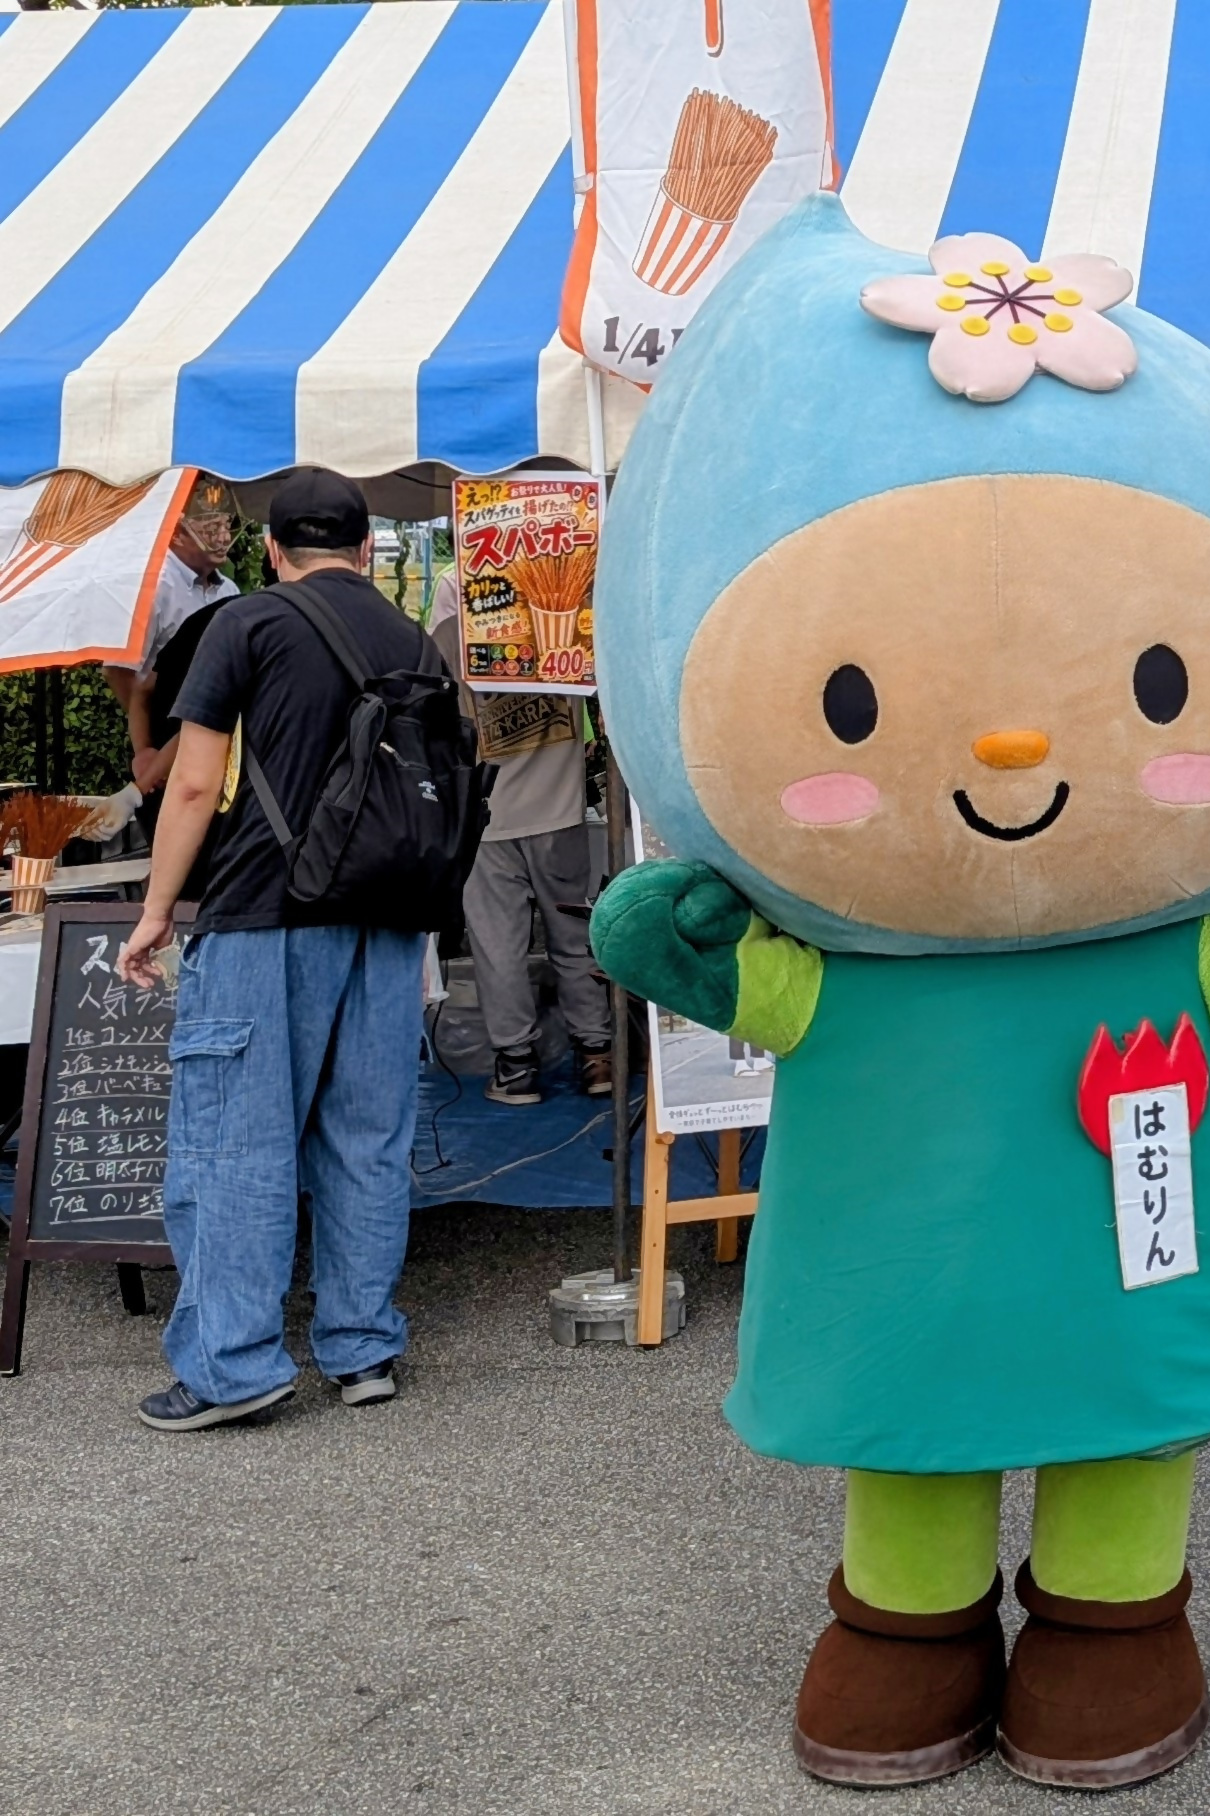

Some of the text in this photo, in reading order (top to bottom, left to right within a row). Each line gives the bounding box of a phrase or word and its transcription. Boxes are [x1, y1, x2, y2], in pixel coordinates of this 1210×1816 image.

[465, 519, 594, 574] スパボー
[468, 580, 506, 598] カリッと
[65, 1023, 167, 1046] 1位 コンソメ
[58, 1053, 94, 1076] 2位
[56, 1080, 92, 1101] 3位
[54, 1104, 166, 1131] 4位 キャラメル
[53, 1133, 168, 1156] 5位 塩レモン
[51, 1161, 90, 1187] 6位
[1134, 1101, 1175, 1271] はむりん
[49, 1194, 88, 1222] 7位
